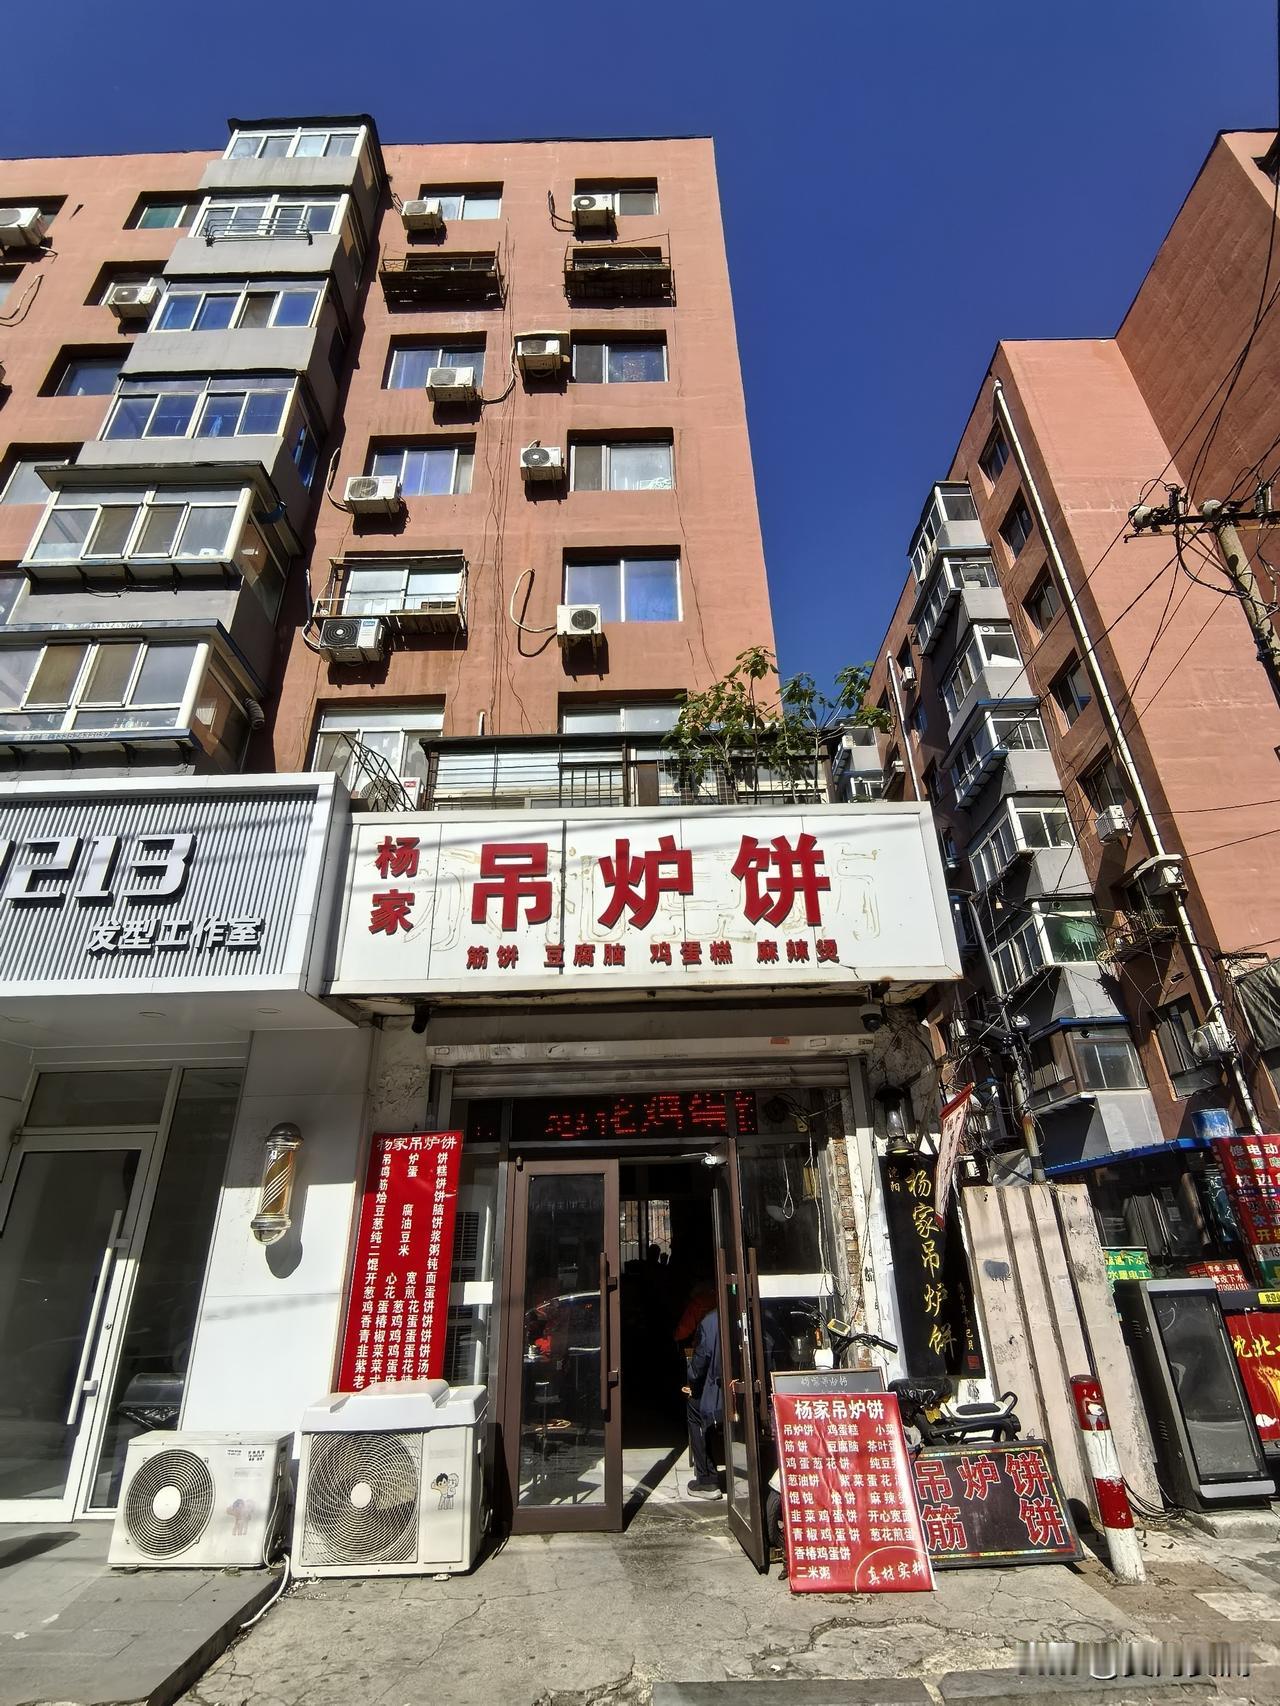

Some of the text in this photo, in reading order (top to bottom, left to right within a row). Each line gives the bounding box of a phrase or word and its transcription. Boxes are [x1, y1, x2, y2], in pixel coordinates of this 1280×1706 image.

[367, 835, 421, 936] 杨家
[471, 832, 832, 932] 吊炉饼
[86, 915, 265, 956] 发型工作室
[466, 938, 840, 970] 筋饼 豆腐脑 鸡蛋糕 麻辣烫
[377, 1135, 457, 1151] 杨家吊炉饼
[905, 1167, 957, 1360] 杨家吊炉饼
[794, 1399, 885, 1420] 杨家吊炉饼
[784, 1424, 814, 1436] 吊炉饼
[827, 1424, 859, 1436] 鸡蛋糕
[784, 1440, 808, 1453] 筋饼
[827, 1440, 859, 1453] 豆腐脑
[785, 1457, 851, 1470] 鸡蛋葱花饼
[788, 1474, 820, 1487] 葱油饼
[914, 1451, 1052, 1503] 吊炉饼
[788, 1491, 815, 1505] 馄饨
[791, 1509, 858, 1523] 韭菜鸡蛋饼
[868, 1509, 913, 1523] 开心宽面
[921, 1497, 1065, 1552] 筋饼
[792, 1527, 861, 1542] 青椒鸡蛋饼
[869, 1527, 916, 1542] 葱花煎蛋
[794, 1546, 851, 1561] 香椿鸡蛋饼
[796, 1566, 831, 1580] 二米粥
